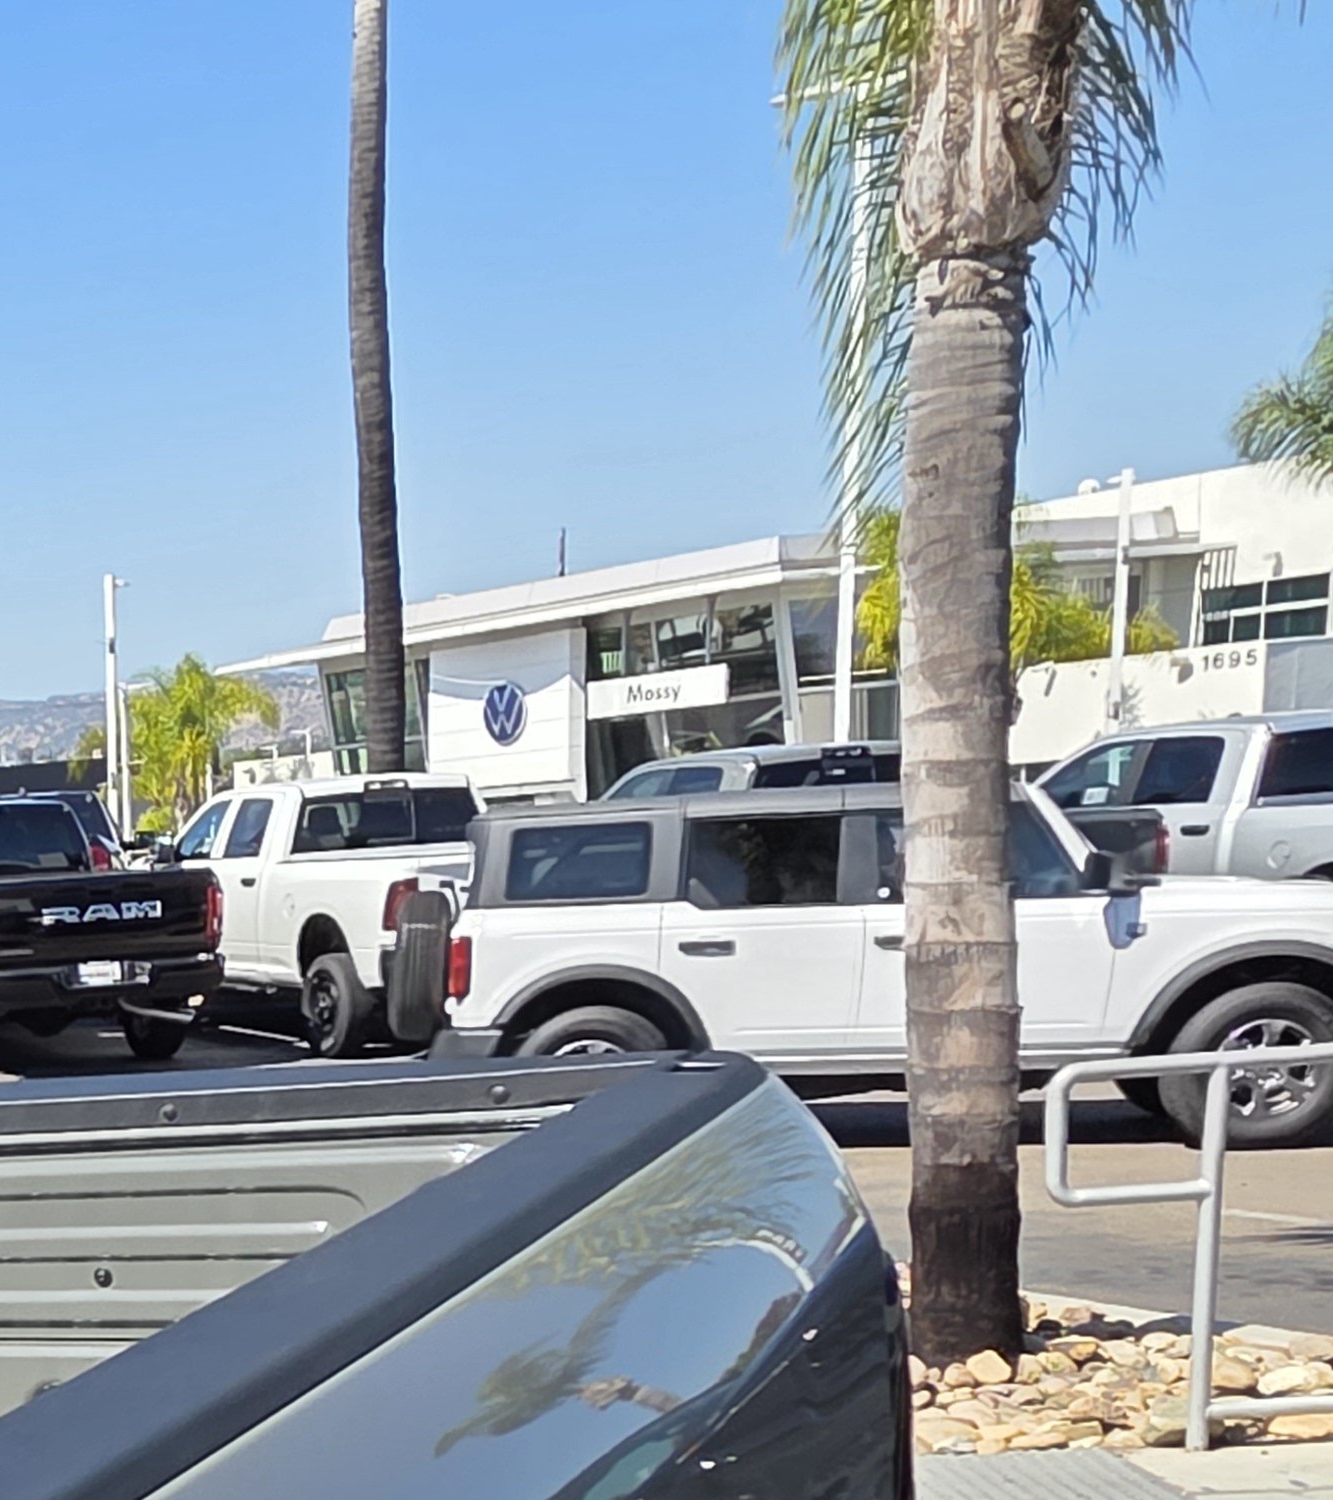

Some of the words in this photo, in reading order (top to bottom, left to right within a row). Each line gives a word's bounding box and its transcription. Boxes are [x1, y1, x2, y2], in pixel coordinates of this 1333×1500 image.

[1202, 648, 1258, 672] 1695
[627, 683, 682, 703] Mossy
[485, 683, 527, 746] VW
[41, 899, 162, 925] RAM
